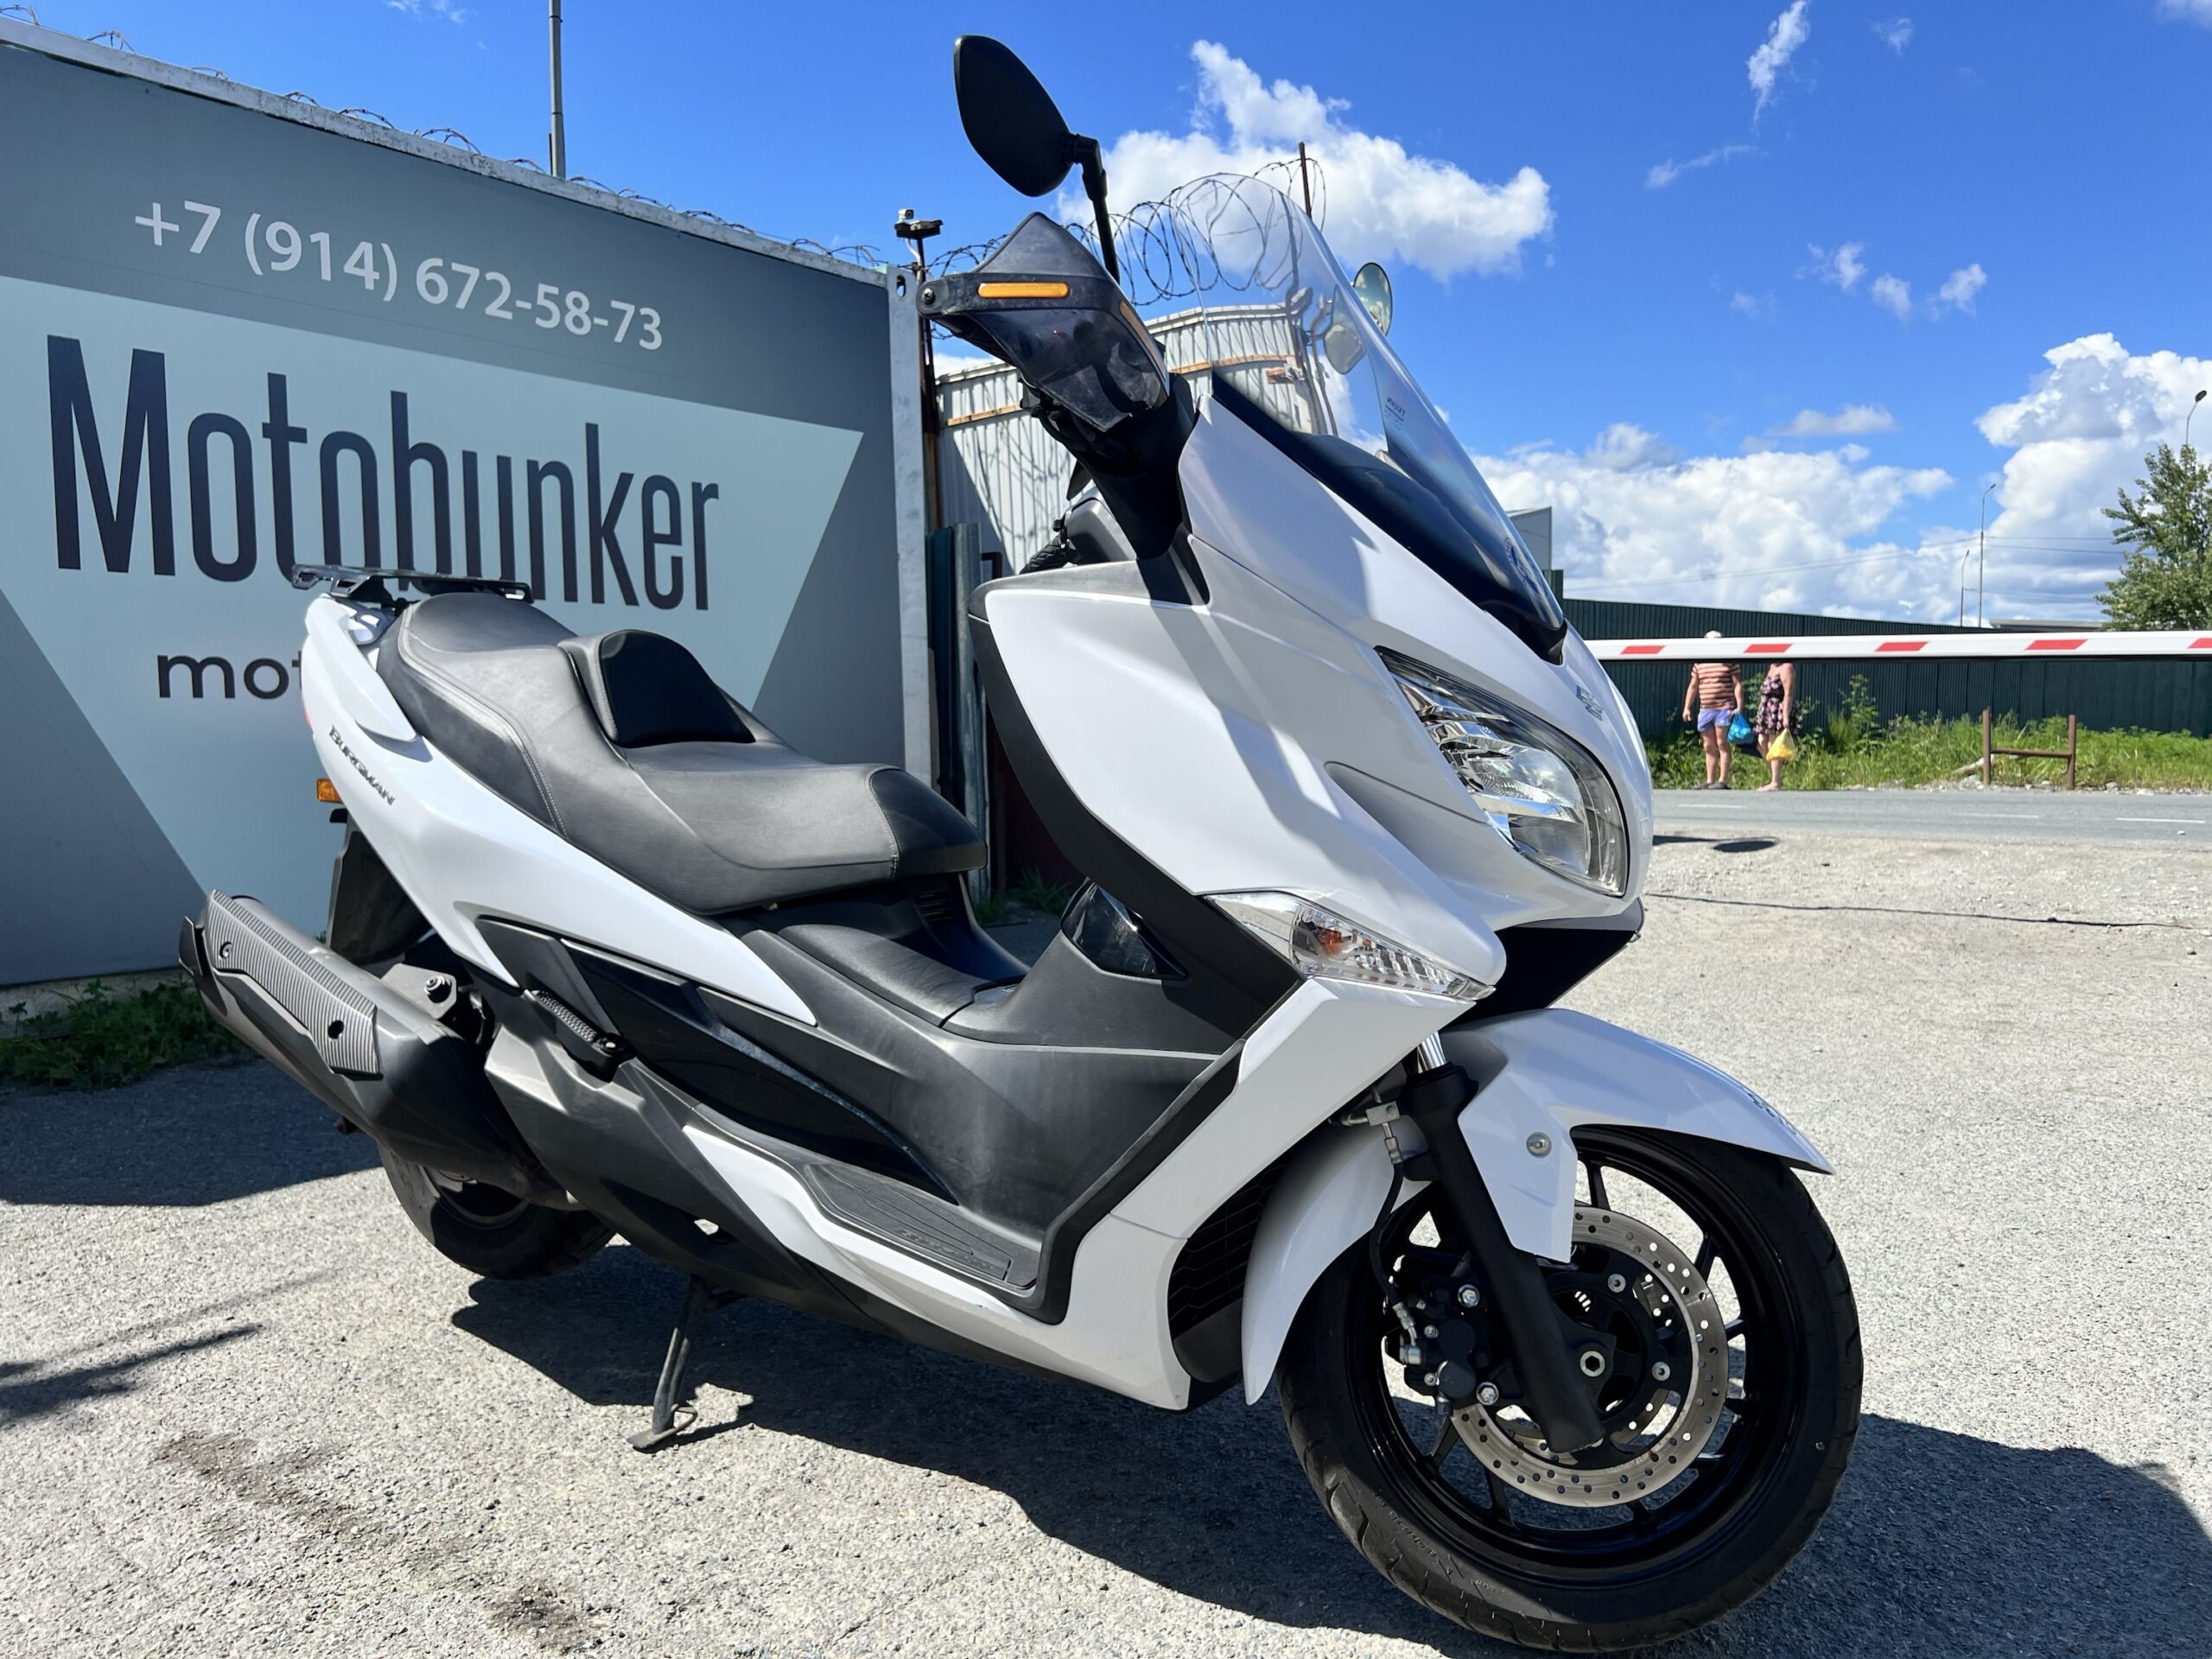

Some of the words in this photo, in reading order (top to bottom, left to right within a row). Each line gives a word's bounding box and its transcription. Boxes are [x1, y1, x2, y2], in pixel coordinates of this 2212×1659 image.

[135, 200, 221, 254] +7
[245, 213, 397, 302] (914)
[416, 257, 663, 351] 672-58-73
[328, 724, 396, 805] BURGMAN
